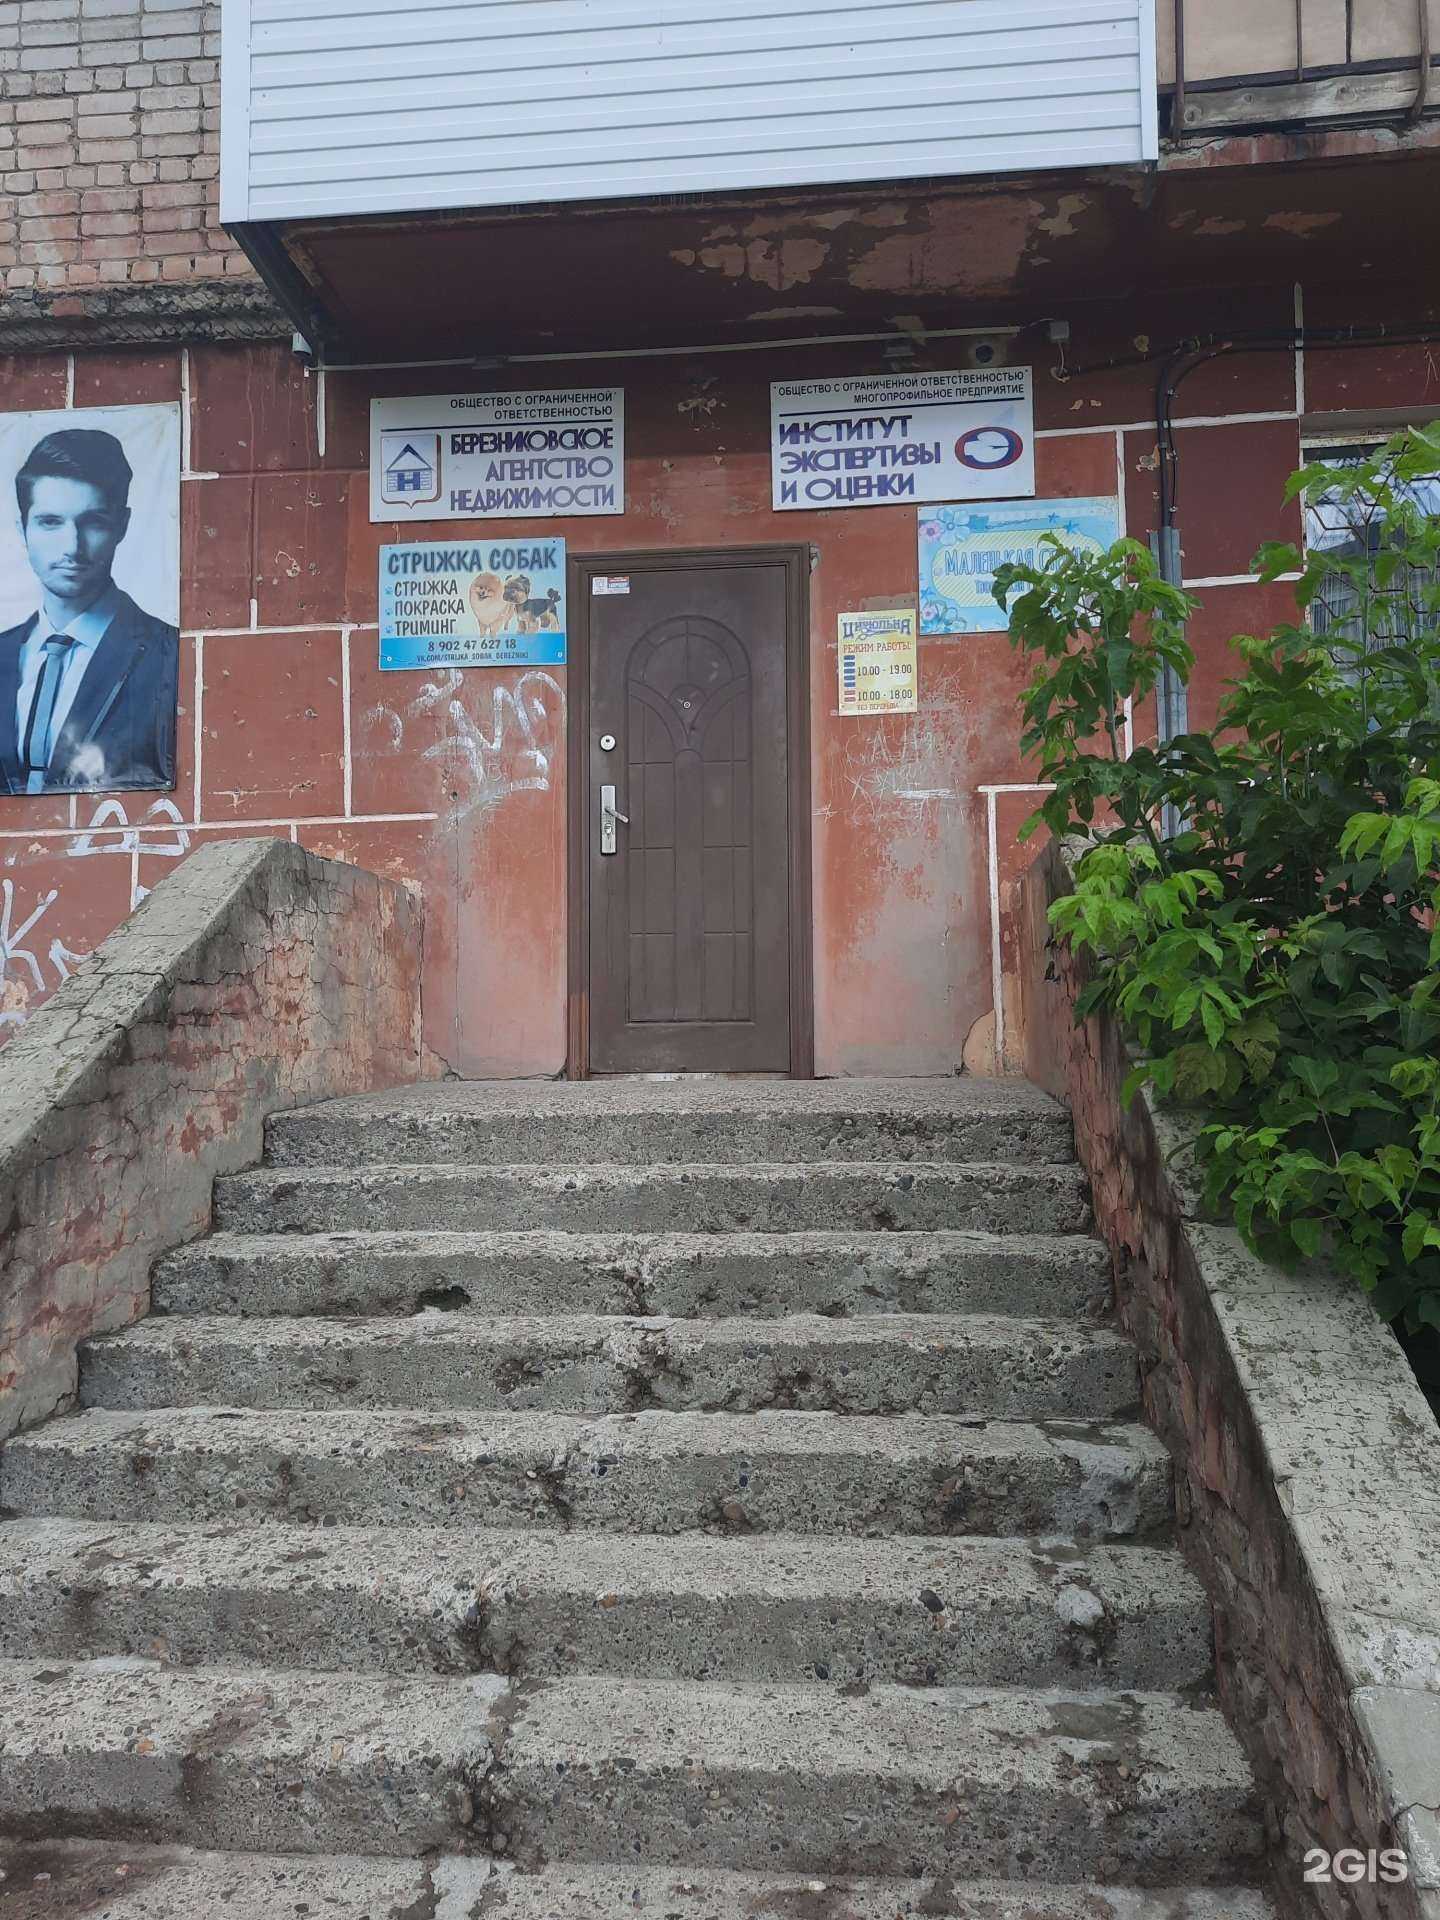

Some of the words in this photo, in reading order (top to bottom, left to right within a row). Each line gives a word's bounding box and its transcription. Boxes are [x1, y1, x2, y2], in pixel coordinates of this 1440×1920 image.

[778, 384, 831, 396] ОБЩЕСТВО
[833, 383, 841, 392] С
[842, 376, 918, 392] ОГРАНИЧЕННОЙ
[920, 371, 1024, 386] ОТВЕТСТВЕННОСТЬЮ
[450, 397, 511, 409] ОБЩЕСТВО
[514, 396, 522, 406] С
[525, 391, 612, 405] ОГРАНИЧЕННОЙ
[854, 388, 953, 404] МНОГОПРОФИЛЬНОЕ
[955, 384, 1024, 398] ПРЕДПРИЯТИЕ
[494, 406, 612, 420] ОТВЕТСТВЕННОСТЬЮ
[779, 415, 912, 446] ИНСТИТУТ
[450, 427, 614, 455] БЕРЕЗНИКОВСКОЕ
[780, 442, 941, 474] ЭКСПЕРТИЗЫ
[485, 456, 614, 482] АГЕНТСТВО
[781, 480, 797, 504] И
[805, 473, 915, 502] ОЦЕНКИ
[450, 484, 614, 513] НЕДВИЖИМОСТИ
[387, 551, 482, 575] СТРИЖКА
[489, 547, 557, 571] СОБАК
[394, 579, 458, 598] СТРИЖКА
[394, 599, 465, 617] ПОКРАСКА
[394, 618, 457, 637] ТРИМИНГ
[427, 641, 435, 652] 8
[438, 640, 460, 652] 902
[463, 640, 477, 651] 47
[480, 639, 501, 650] 627
[504, 638, 516, 650] 18
[843, 643, 874, 654] РЕЖИМ
[857, 665, 880, 677] 10.00
[889, 664, 912, 675] 19.00
[857, 690, 880, 701] 10.00
[889, 689, 913, 700] 18.00
